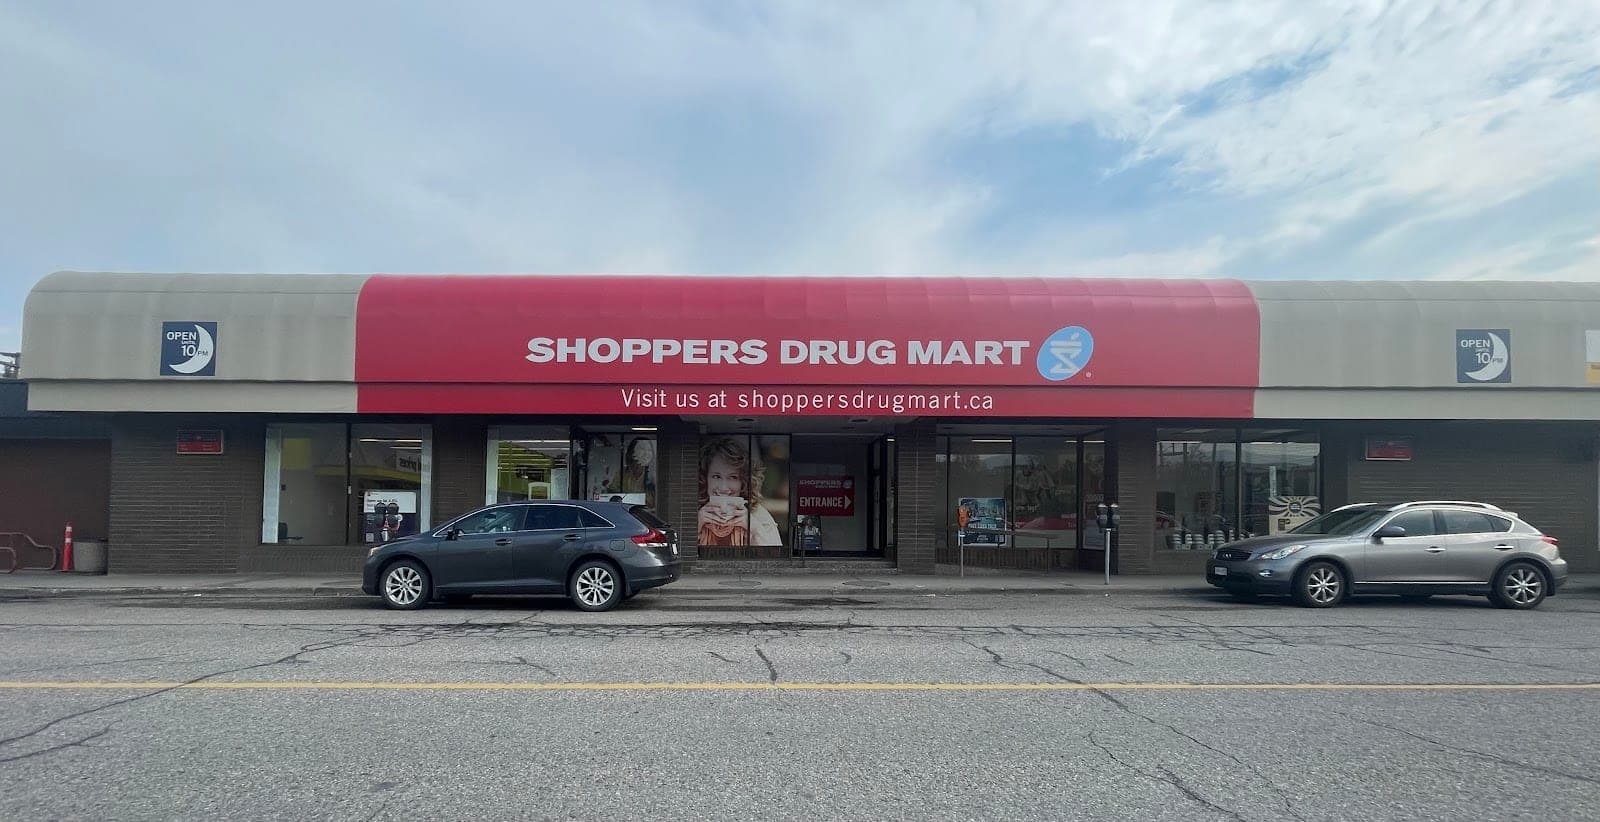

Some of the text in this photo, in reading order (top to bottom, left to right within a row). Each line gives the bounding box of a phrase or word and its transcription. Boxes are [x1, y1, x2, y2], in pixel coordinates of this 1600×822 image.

[166, 331, 197, 341] OPEN
[1460, 339, 1490, 348] OPEN
[181, 345, 196, 357] 10
[525, 337, 1029, 365] SHOPPERS DRUG MART
[1475, 352, 1491, 364] 10
[621, 389, 993, 413] Visit us at shoppersdrugmart.ca
[799, 497, 843, 507] ENTRANCE
